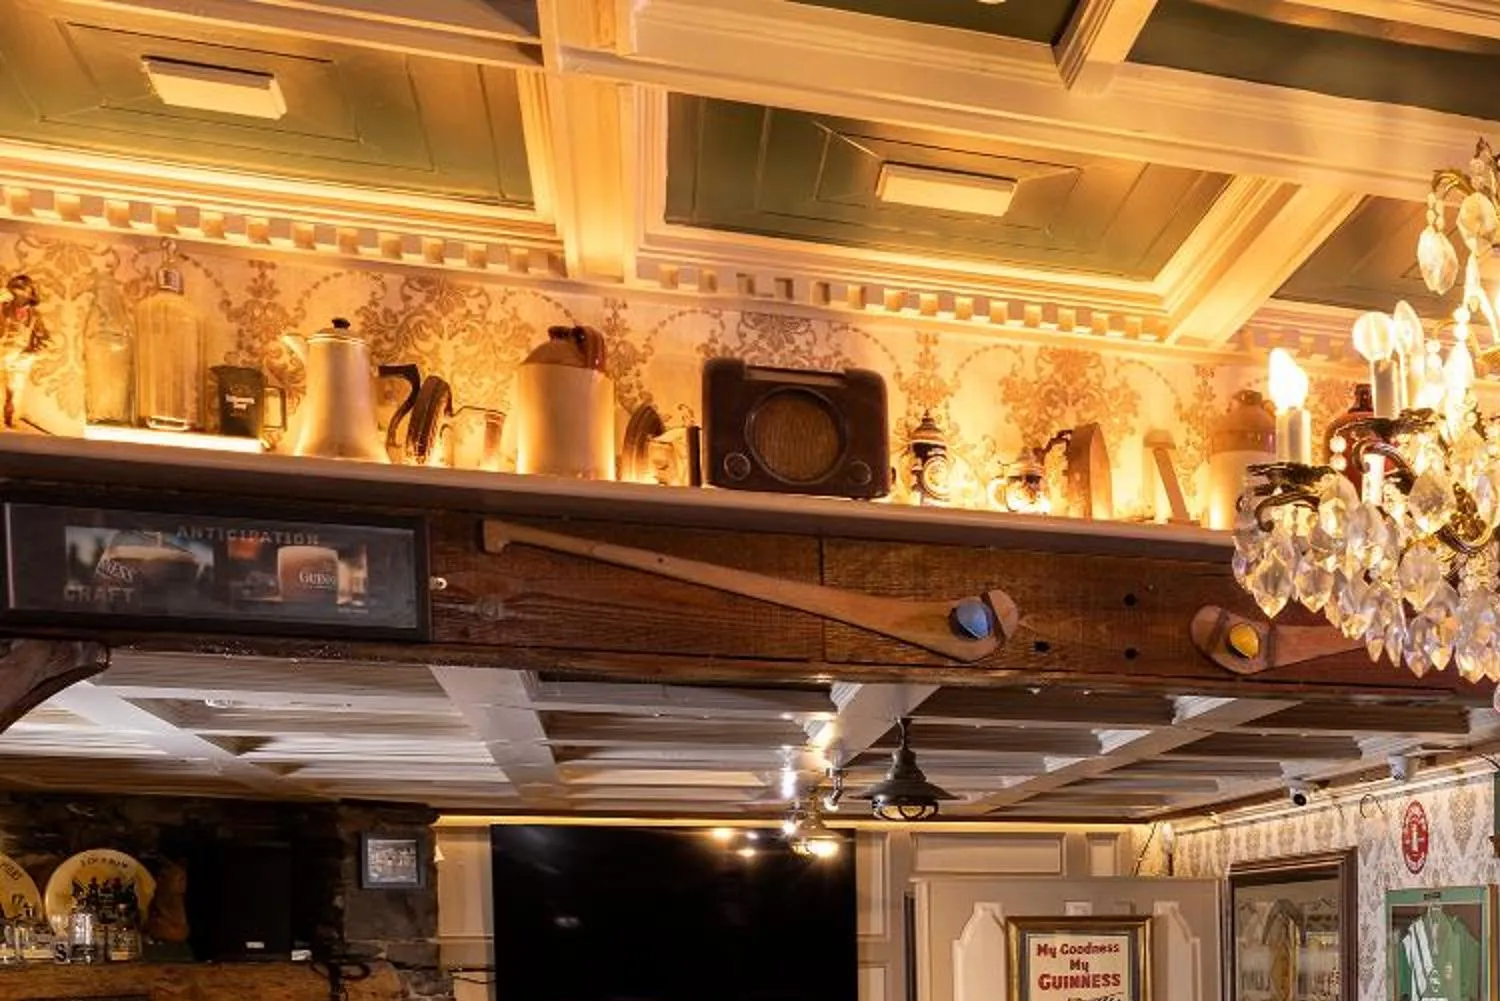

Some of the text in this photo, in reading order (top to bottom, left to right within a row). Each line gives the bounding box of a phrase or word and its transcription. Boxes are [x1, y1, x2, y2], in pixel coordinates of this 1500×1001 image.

[176, 525, 320, 546] ANTICIPATION
[63, 586, 136, 604] CRAFT
[1036, 942, 1120, 959] My Goodness
[1069, 959, 1090, 972] My
[1037, 973, 1121, 991] GUINNESS
